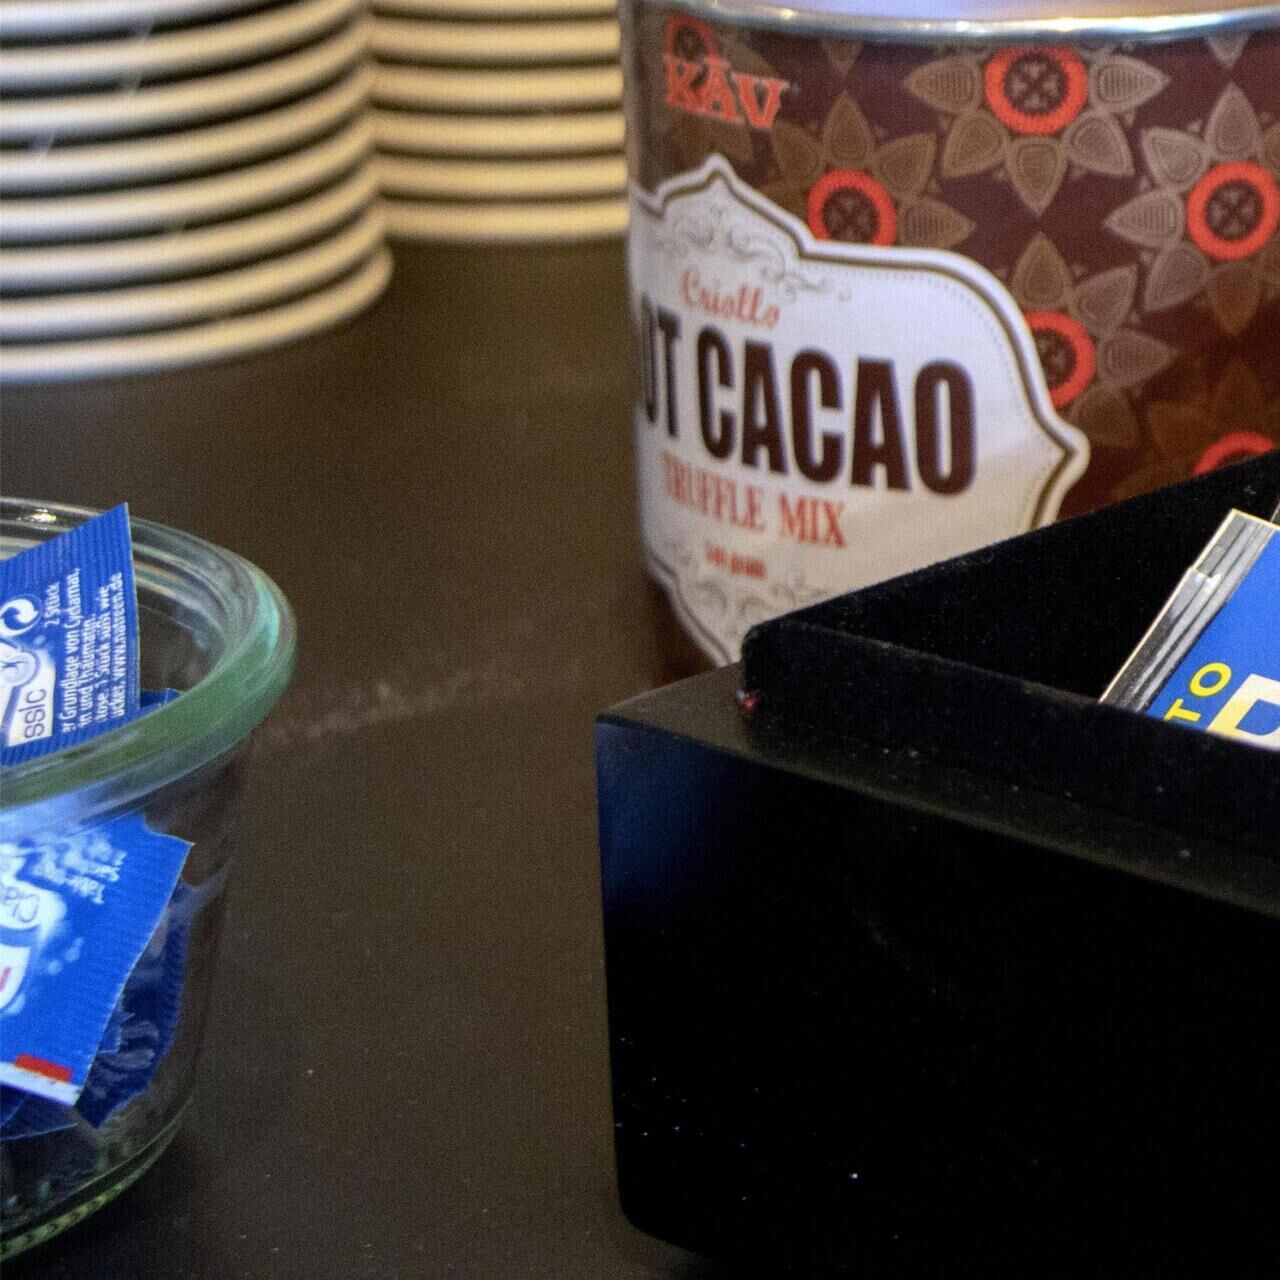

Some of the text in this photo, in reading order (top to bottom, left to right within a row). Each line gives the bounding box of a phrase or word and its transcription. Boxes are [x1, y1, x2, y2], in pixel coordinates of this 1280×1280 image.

[697, 325, 976, 496] CACAO
[778, 492, 847, 548] MIX
[44, 581, 61, 616] Stück
[96, 585, 110, 609] wie
[66, 630, 80, 654] von
[94, 642, 111, 679] Stück
[58, 655, 81, 720] Grundlage
[77, 686, 93, 711] und
